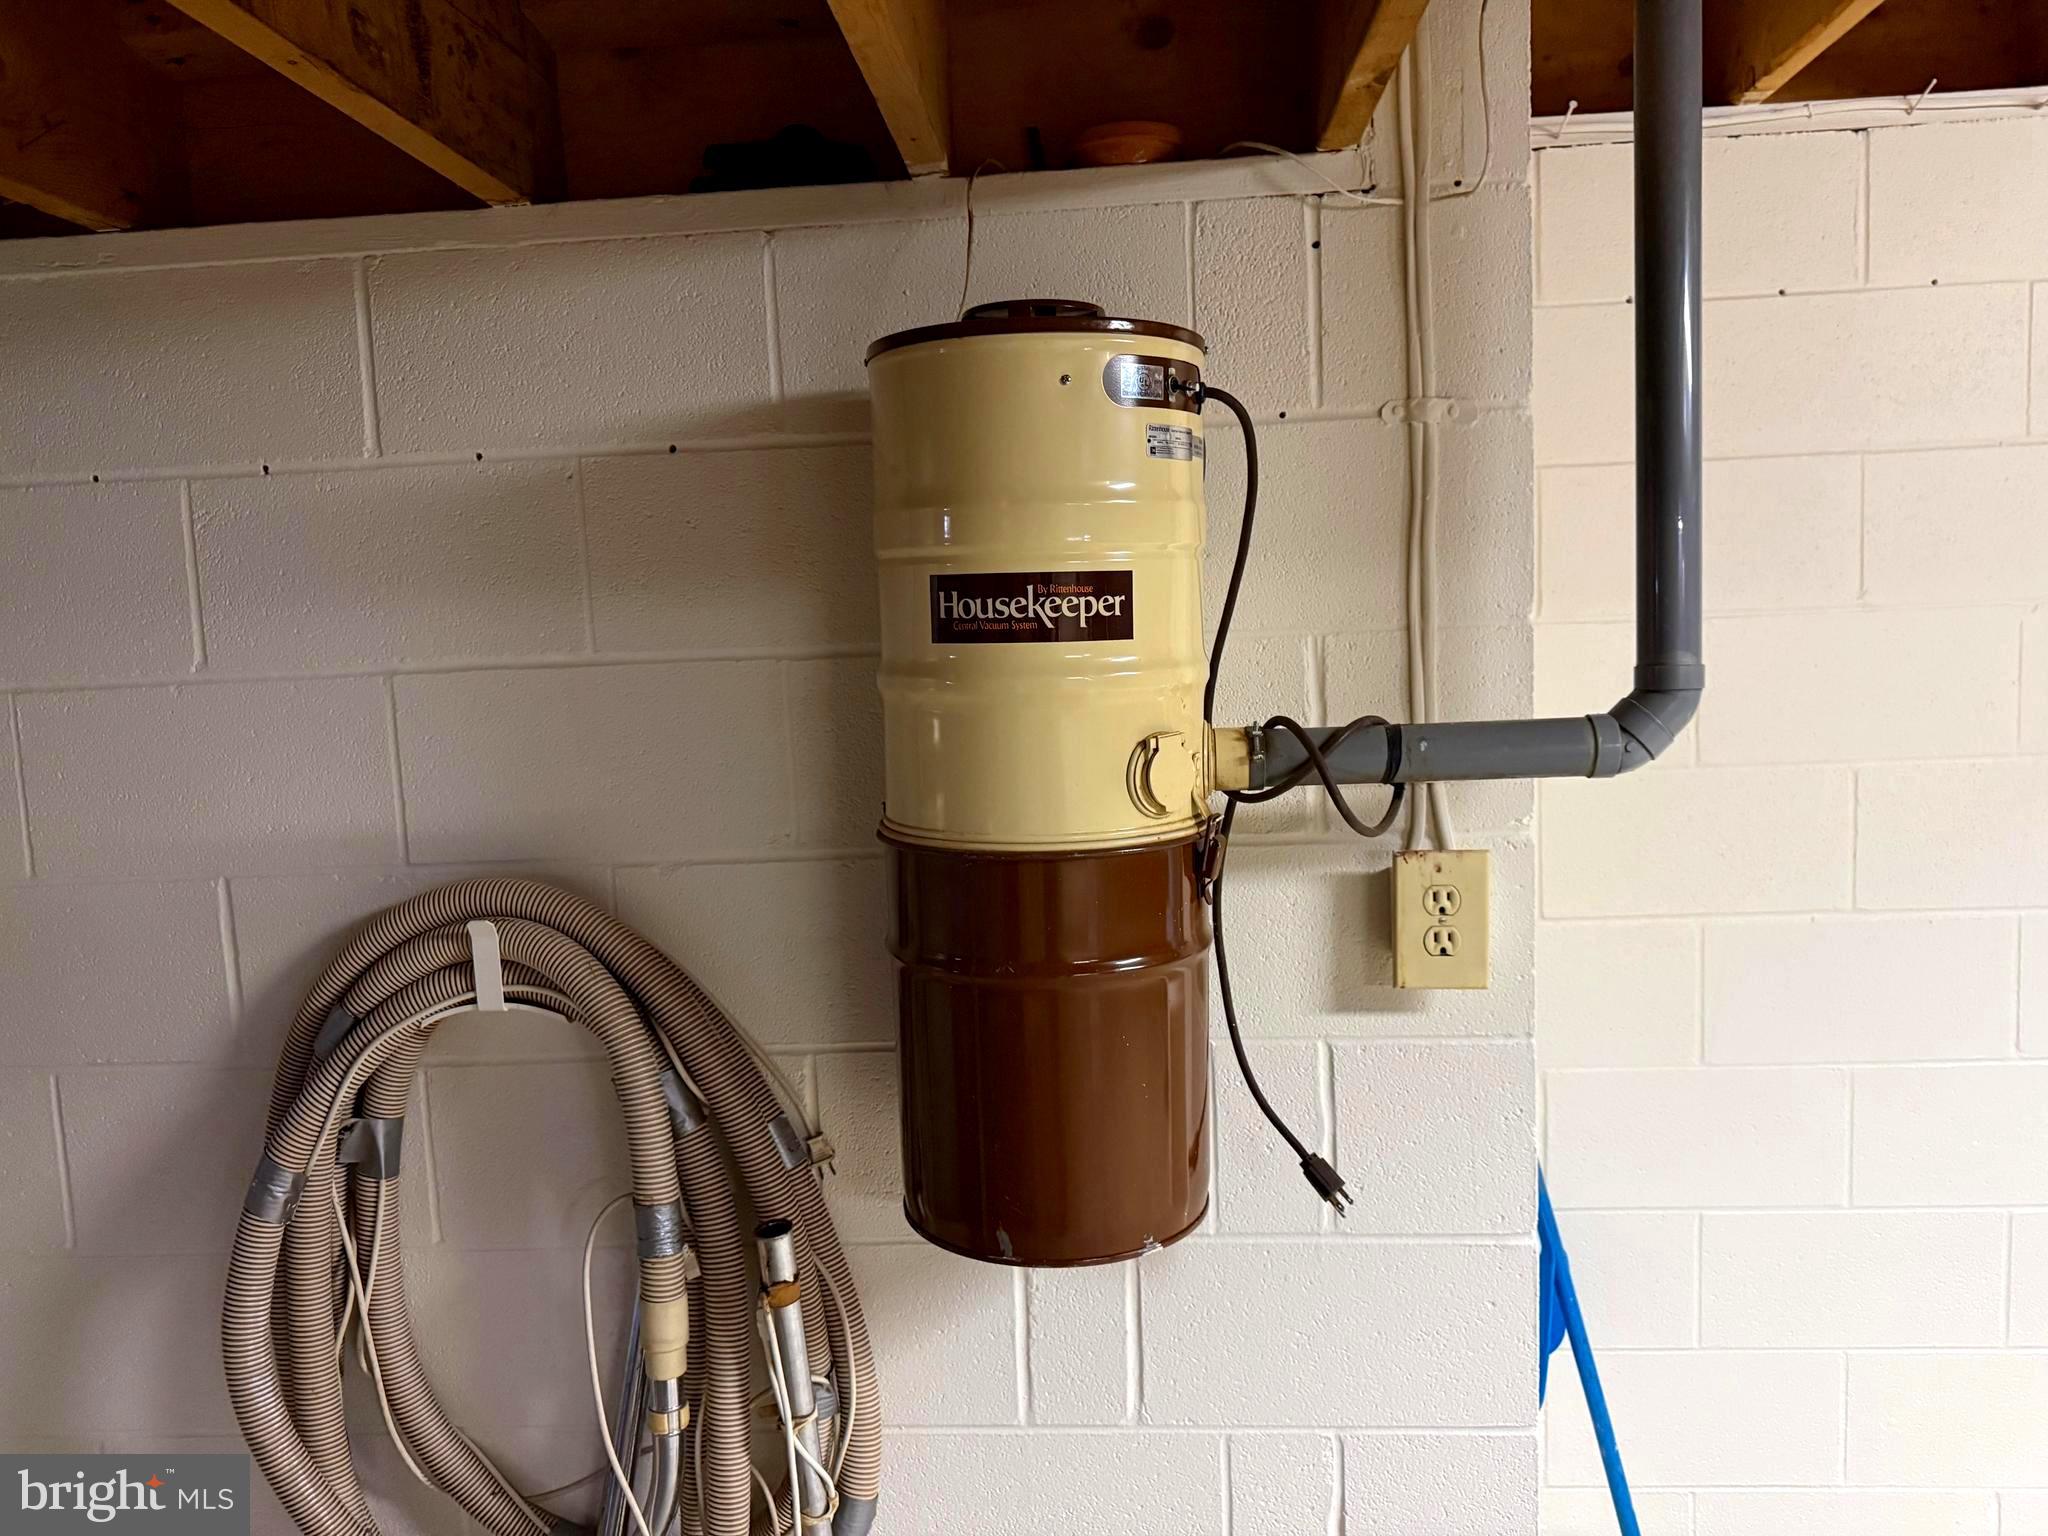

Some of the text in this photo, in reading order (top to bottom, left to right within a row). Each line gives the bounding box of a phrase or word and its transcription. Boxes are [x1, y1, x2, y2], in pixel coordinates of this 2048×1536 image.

[1037, 583, 1094, 594] By Rittenhouse
[938, 584, 1126, 629] Housekeeper
[953, 619, 1038, 631] Central Vacuum System
